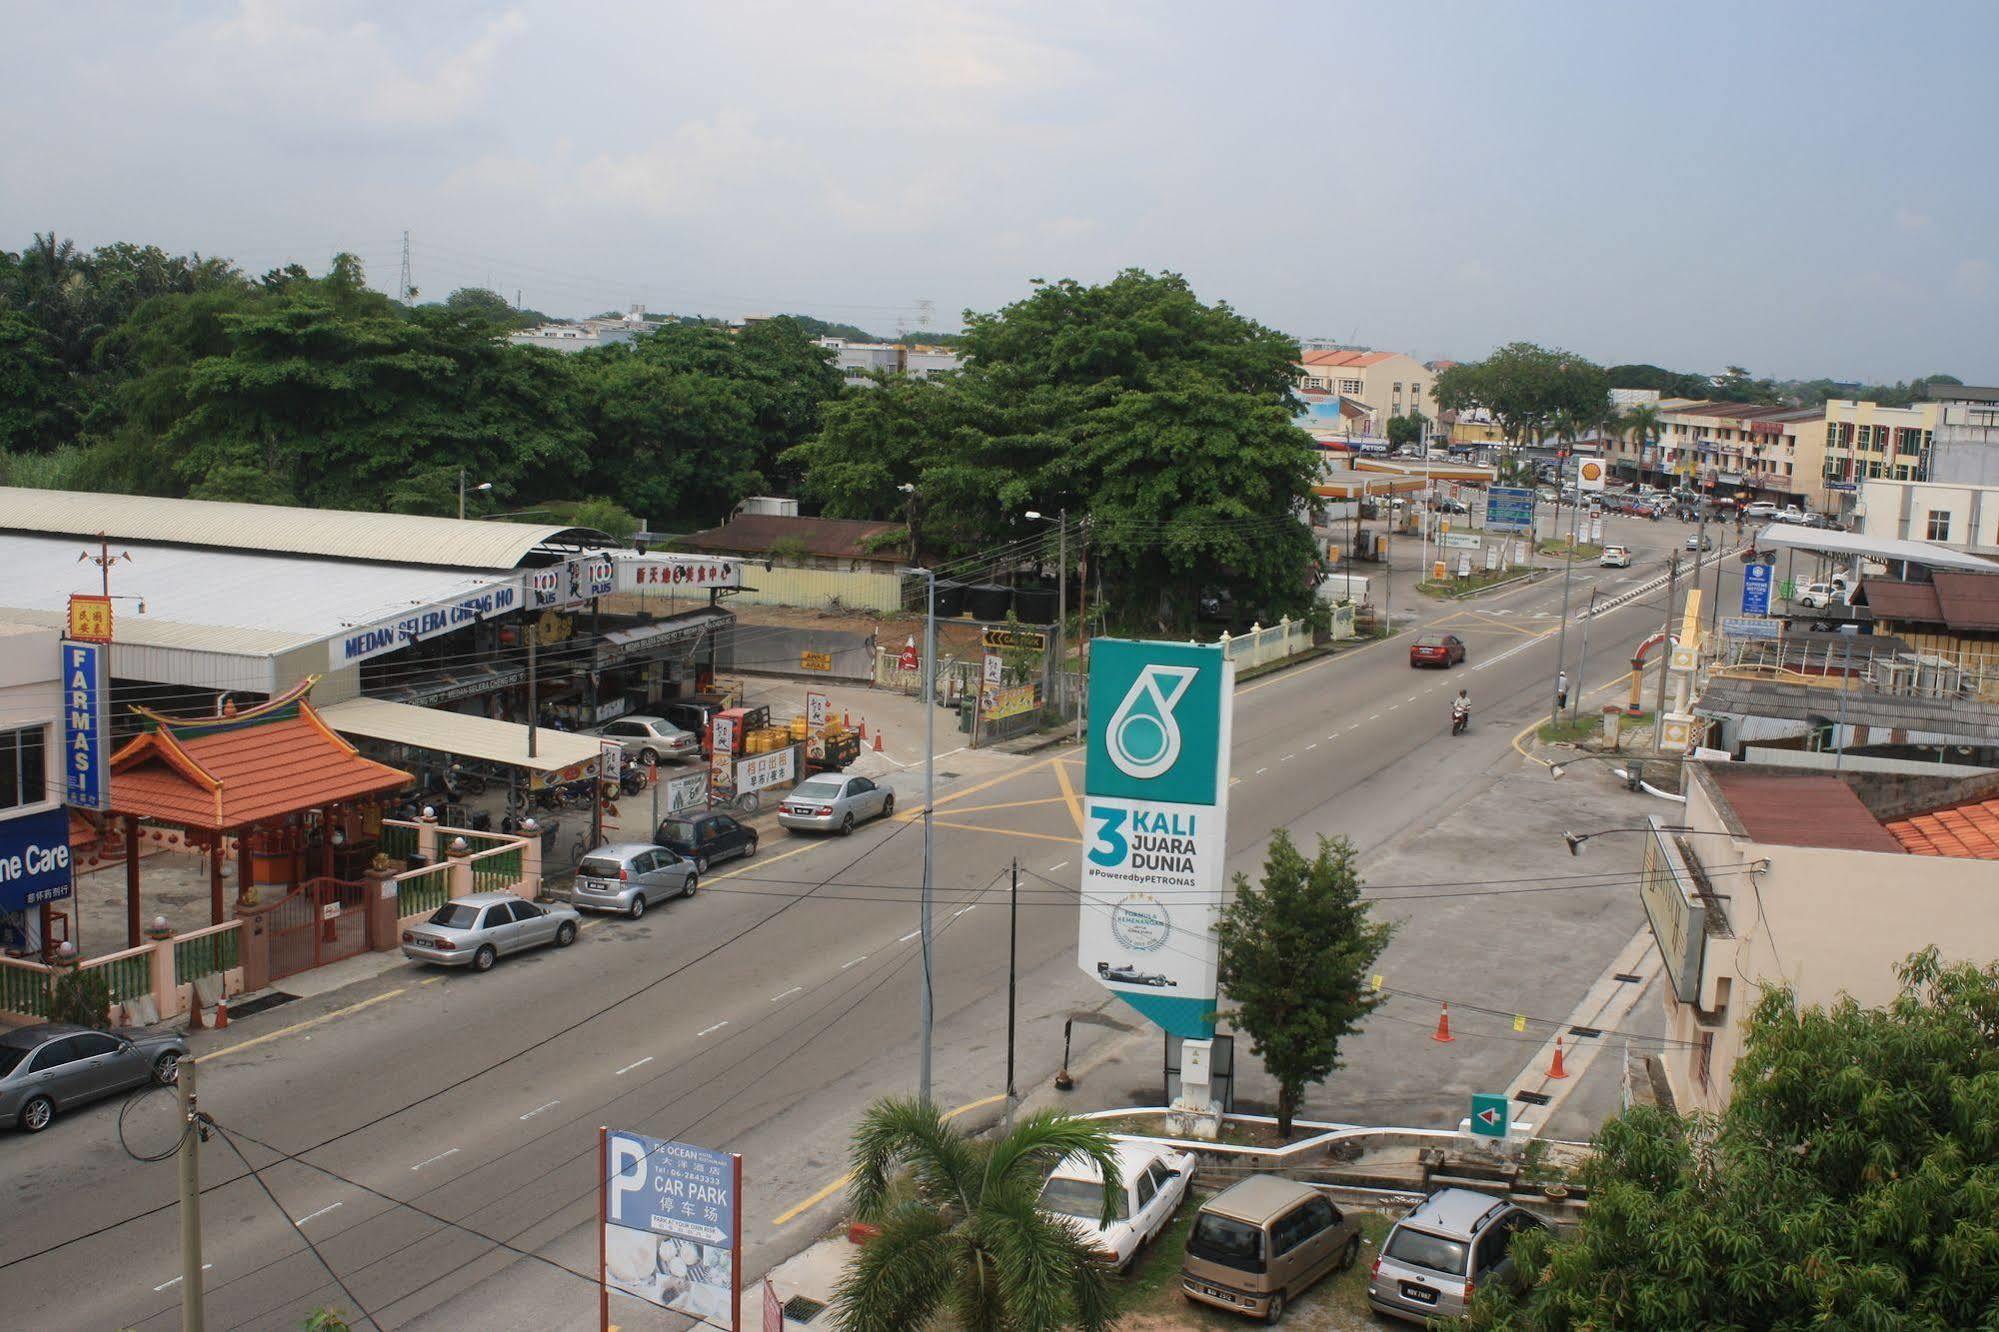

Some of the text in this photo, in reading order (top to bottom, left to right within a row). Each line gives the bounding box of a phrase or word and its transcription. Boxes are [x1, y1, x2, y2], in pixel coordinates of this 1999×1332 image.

[592, 583, 611, 594] PLUS
[345, 588, 513, 660] MEDAN SELERA CHENG HO
[72, 649, 90, 792] FARMASI
[1133, 811, 1195, 836] KALI
[1088, 806, 1127, 867] 3
[1132, 835, 1196, 855] JUARA
[26, 845, 69, 875] Care
[1132, 853, 1194, 873] DUNIA
[1089, 869, 1195, 887] #PoweredbyPETRONAS
[668, 1147, 697, 1160] OCEAN
[612, 1137, 647, 1220] P
[655, 1176, 727, 1206] CAR PARK
[660, 1197, 718, 1222] 停车场
